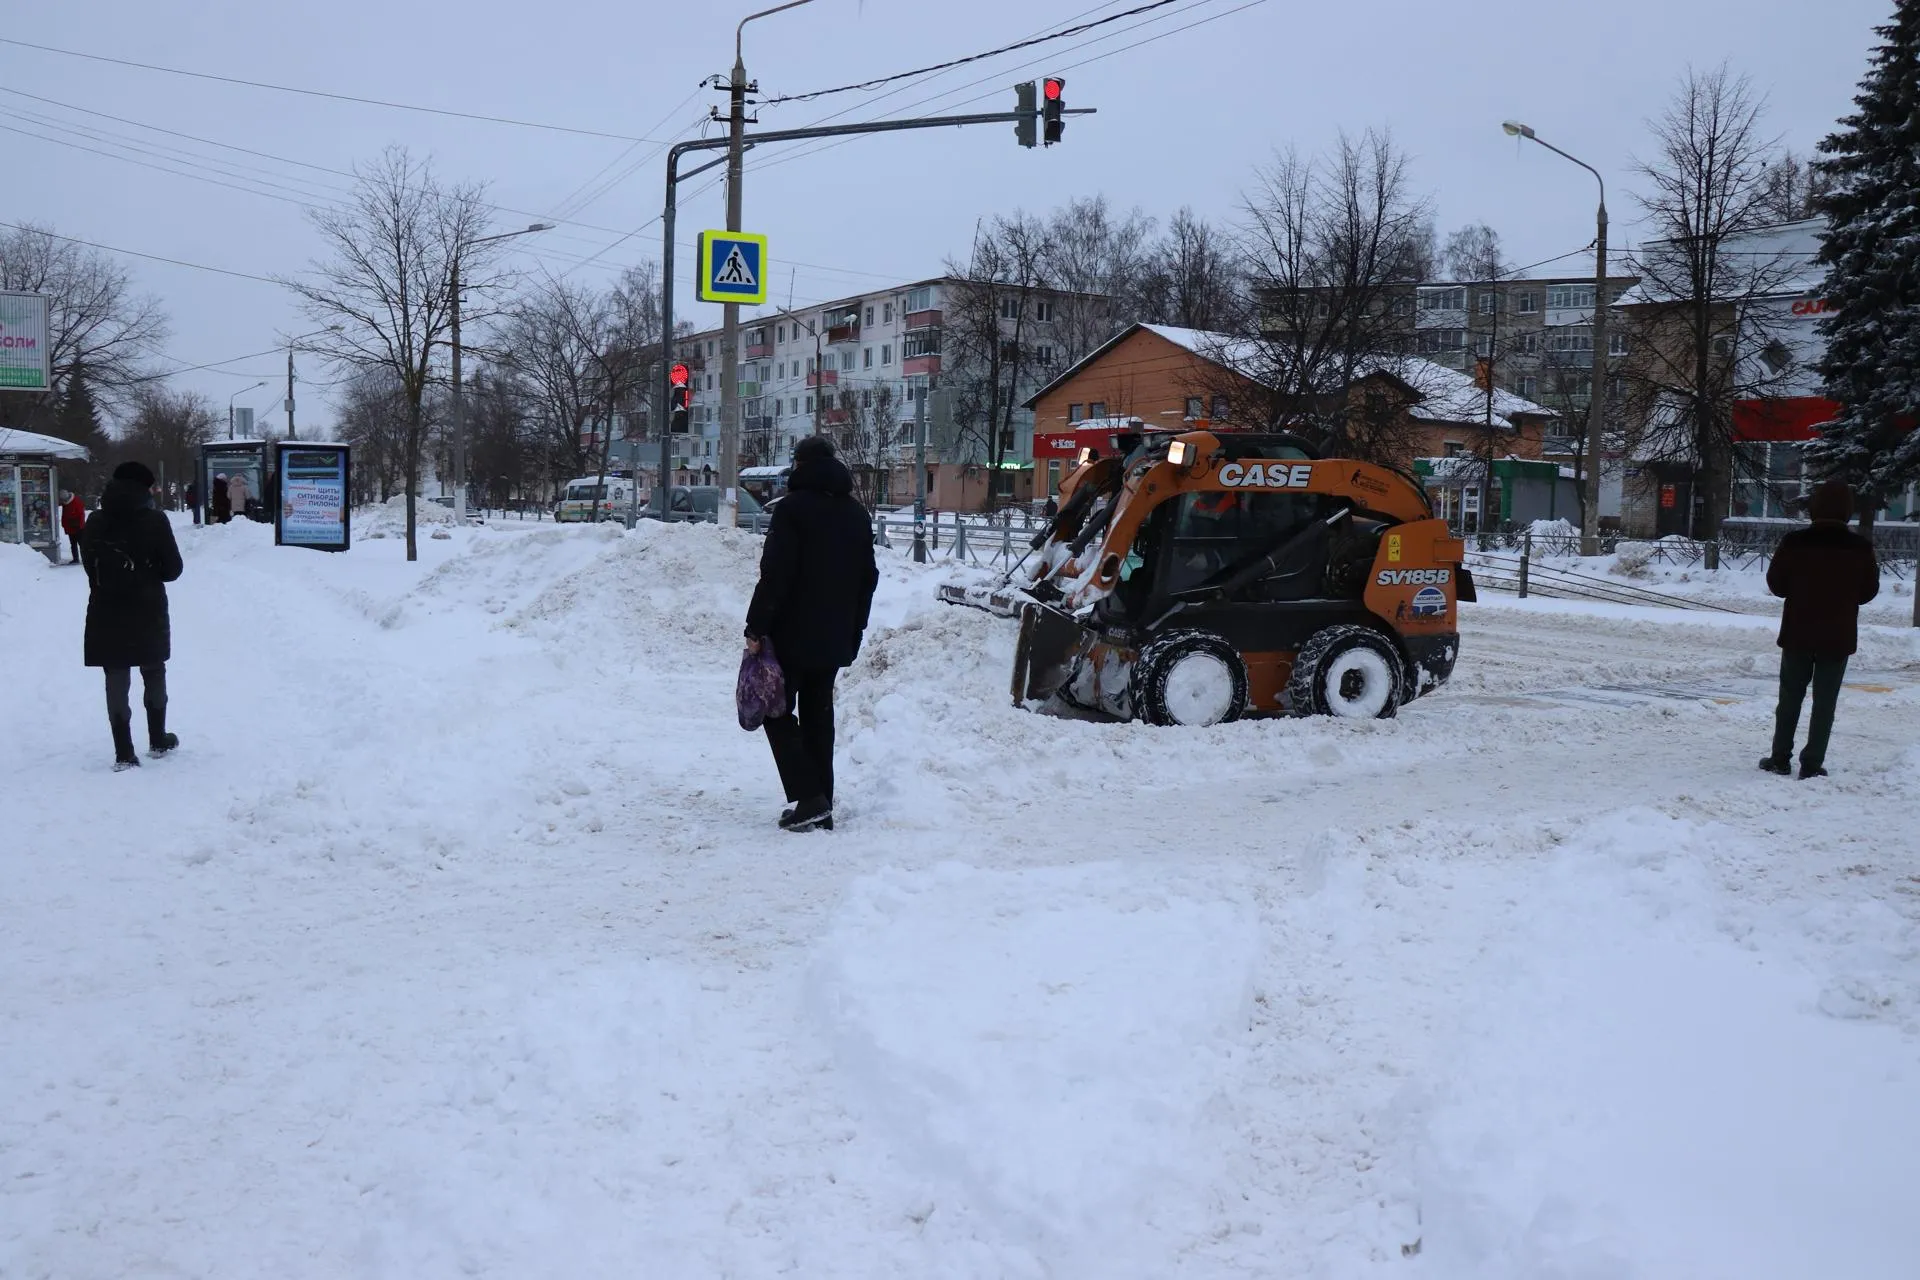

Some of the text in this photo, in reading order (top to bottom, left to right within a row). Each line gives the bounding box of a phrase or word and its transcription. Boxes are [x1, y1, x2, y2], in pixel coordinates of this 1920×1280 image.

[0, 336, 36, 348] ОЛИ
[1218, 463, 1312, 488] CASE
[1377, 569, 1451, 586] SV185B
